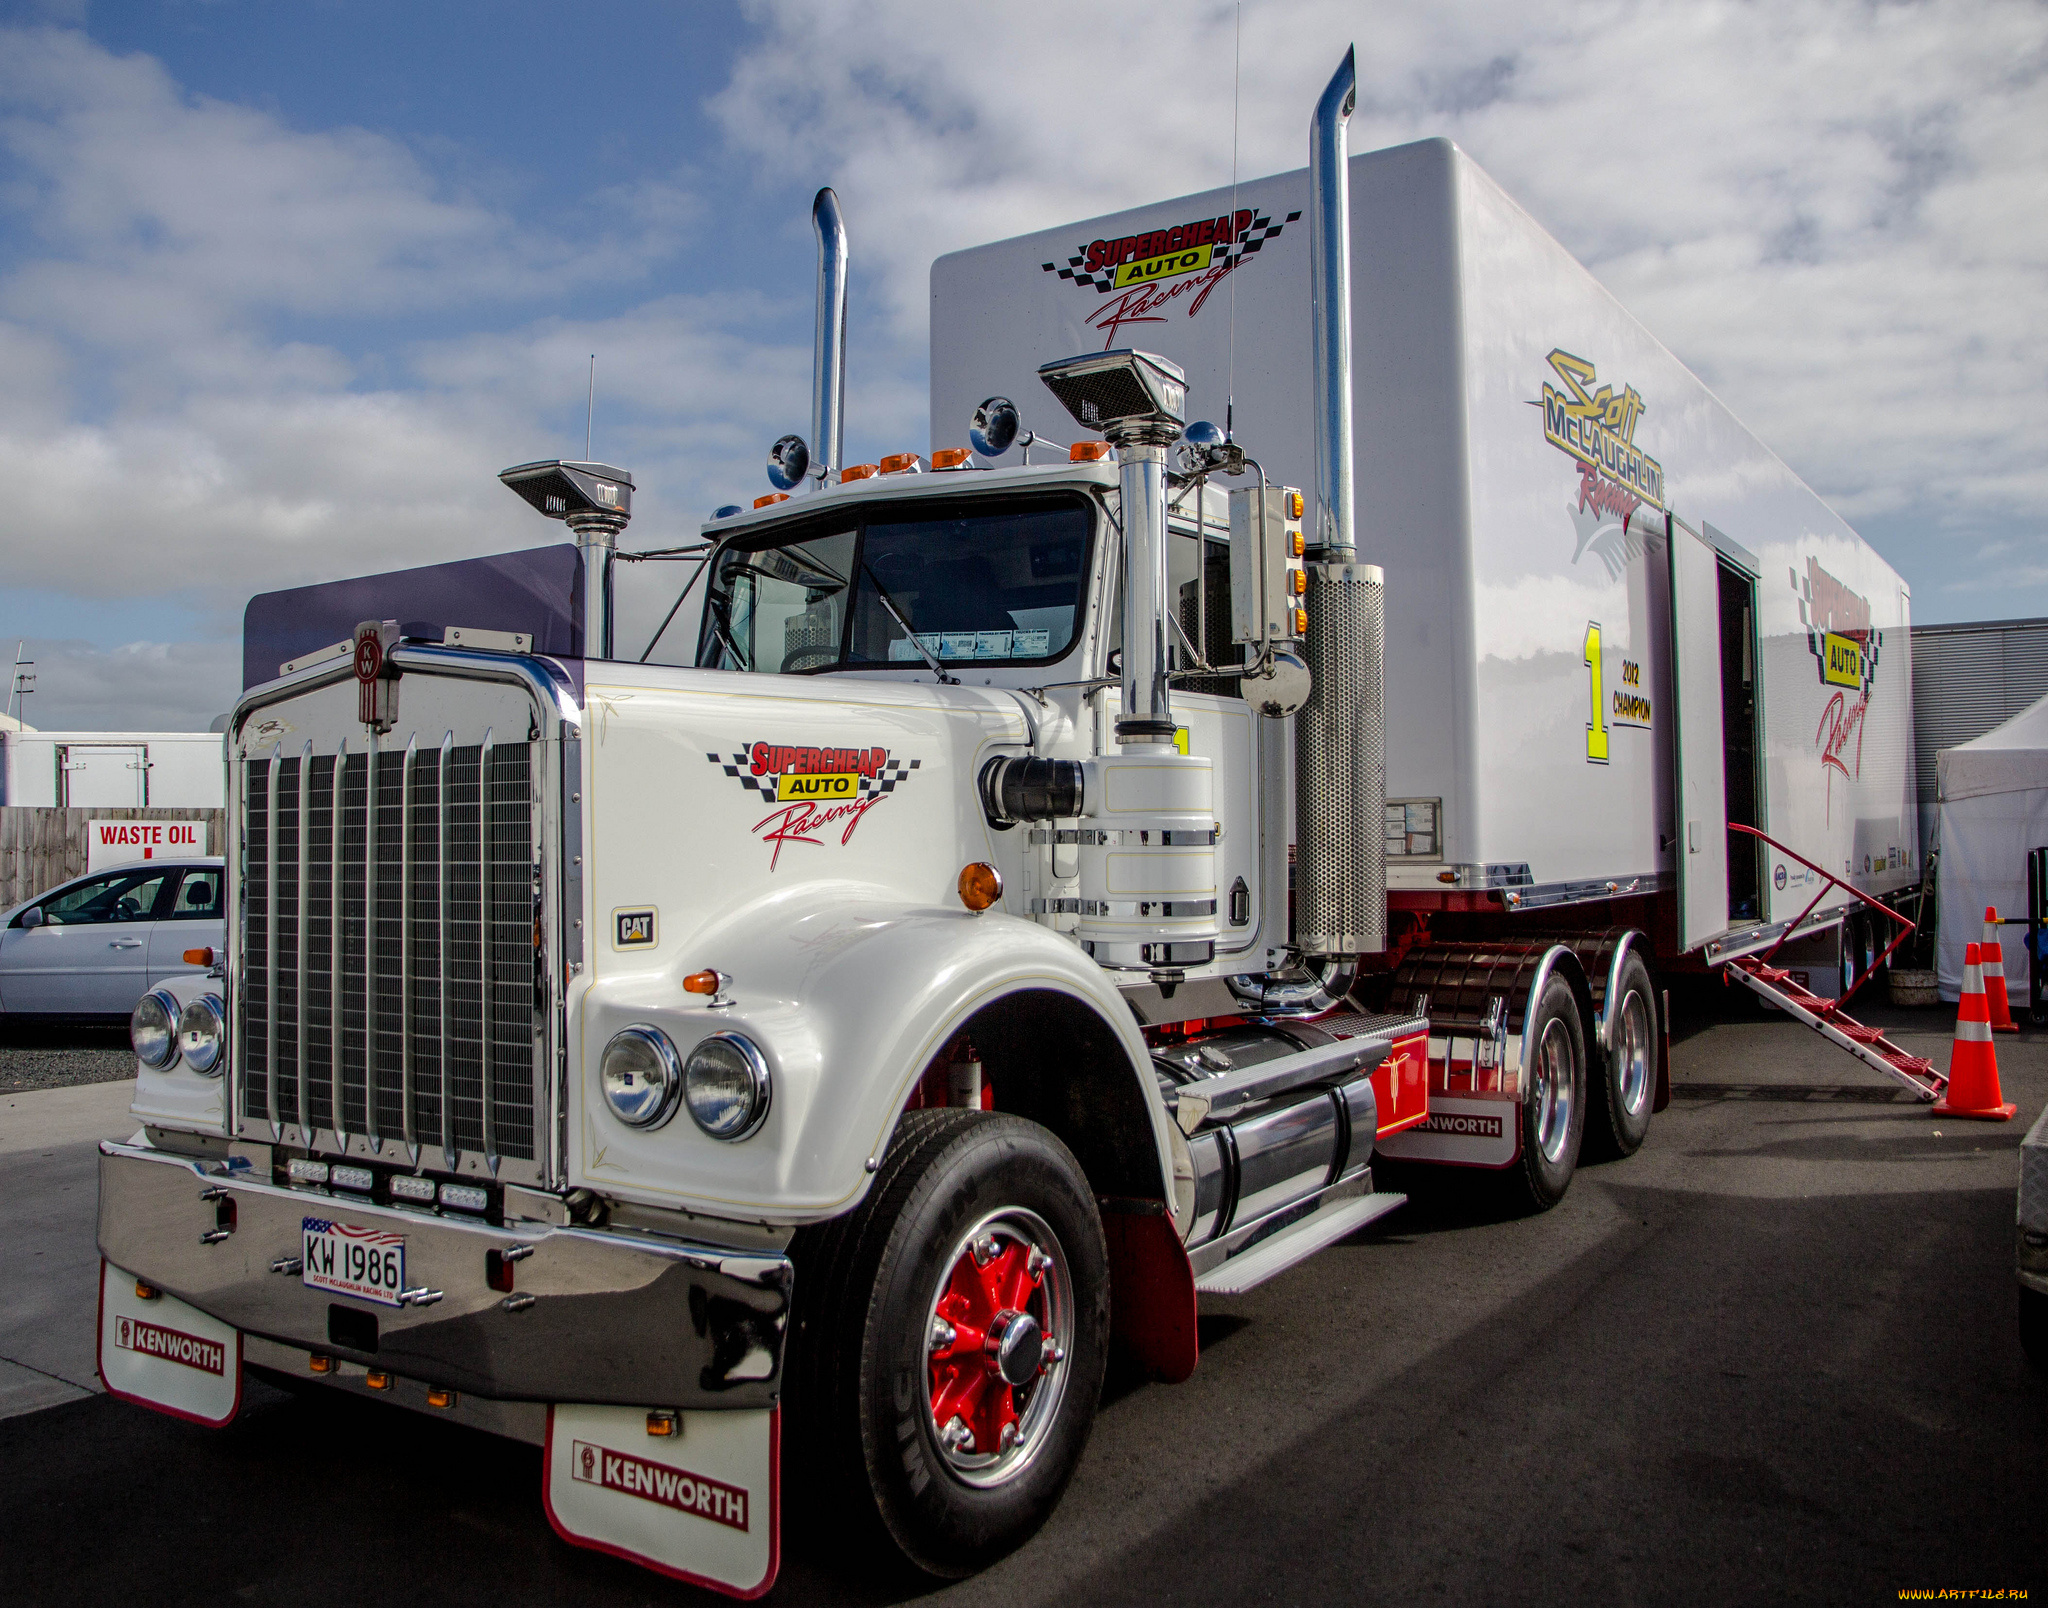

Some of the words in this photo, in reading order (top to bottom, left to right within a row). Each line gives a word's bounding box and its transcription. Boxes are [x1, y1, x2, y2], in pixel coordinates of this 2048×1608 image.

[1083, 208, 1254, 273] SUPERCHEAP
[1126, 251, 1200, 281] AUTO
[1085, 257, 1254, 350] Racing
[1545, 347, 1646, 447] Scott
[1576, 461, 1641, 536] Racing
[1622, 659, 1639, 688] 2012
[1829, 643, 1857, 677] AUTO
[1583, 620, 1609, 765] 1
[1612, 690, 1651, 723] CHAMPION
[750, 741, 887, 778] SUPERCHEAP
[1815, 690, 1872, 830] Racing
[789, 778, 849, 794] AUTO
[100, 826, 162, 845] WASTE
[168, 825, 197, 844] OIL
[751, 795, 888, 872] Racing
[621, 917, 651, 940] CAT
[1412, 1116, 1500, 1135] ENWORTH
[306, 1235, 335, 1275] KW
[344, 1243, 398, 1290] 1986
[312, 1274, 328, 1285] SCOTT
[329, 1278, 361, 1292] MCLAUGHLIN
[362, 1286, 382, 1297] RACING
[383, 1290, 394, 1300] LTD
[136, 1326, 222, 1370] KENWORTH
[605, 1455, 744, 1524] KENWORTH
